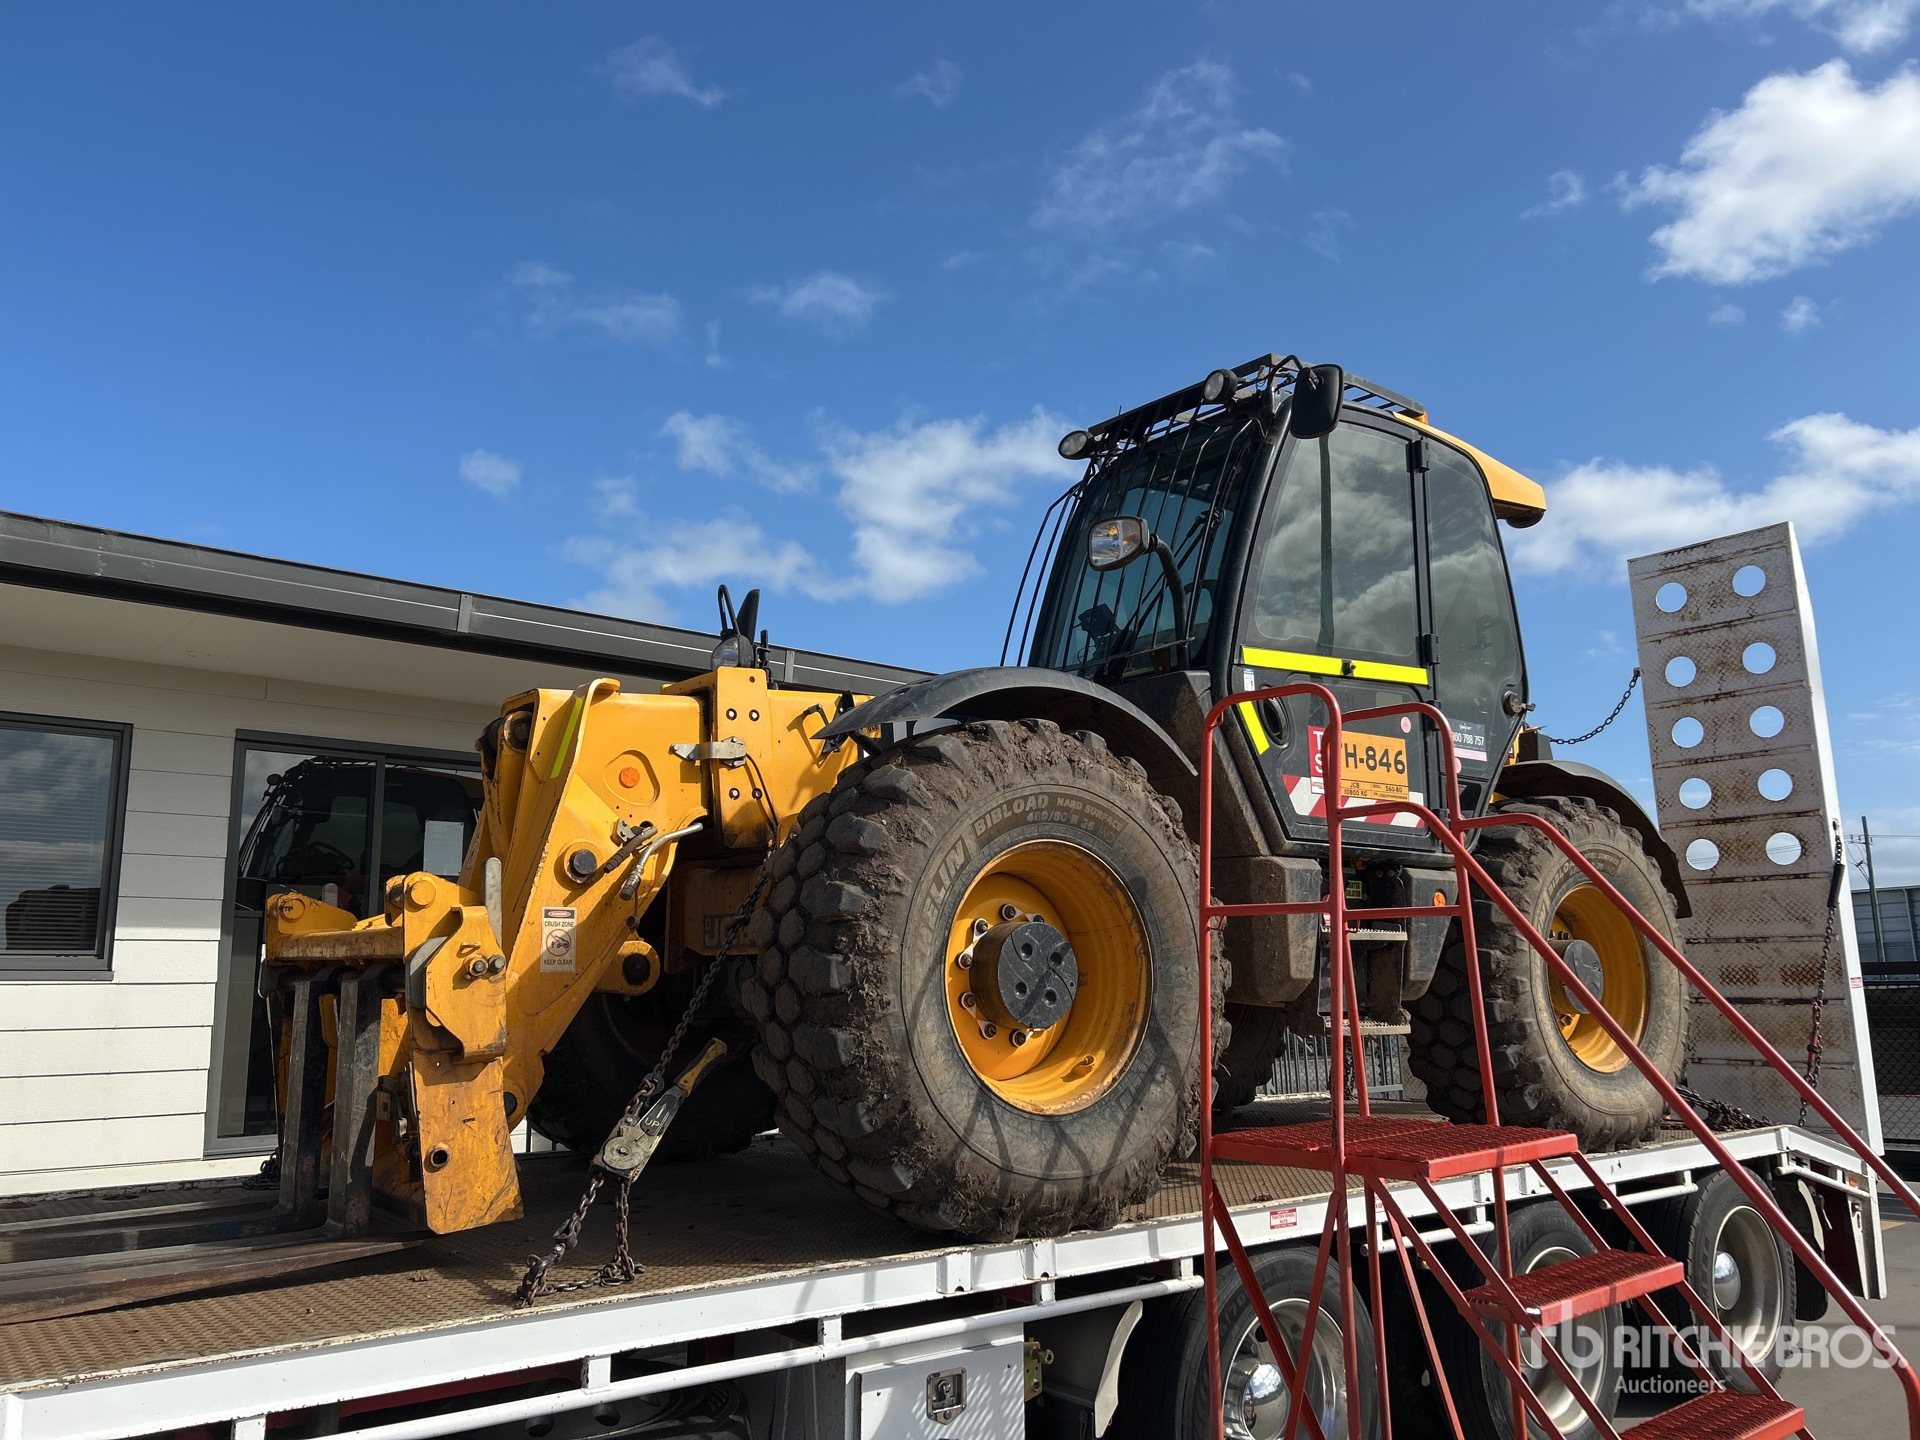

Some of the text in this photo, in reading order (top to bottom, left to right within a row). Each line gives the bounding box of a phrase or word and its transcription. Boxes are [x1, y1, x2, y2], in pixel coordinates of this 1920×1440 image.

[1474, 735, 1485, 746] 757
[1341, 742, 1405, 774] H-846
[974, 794, 1124, 836] BIBLOAD HARD SURFACE
